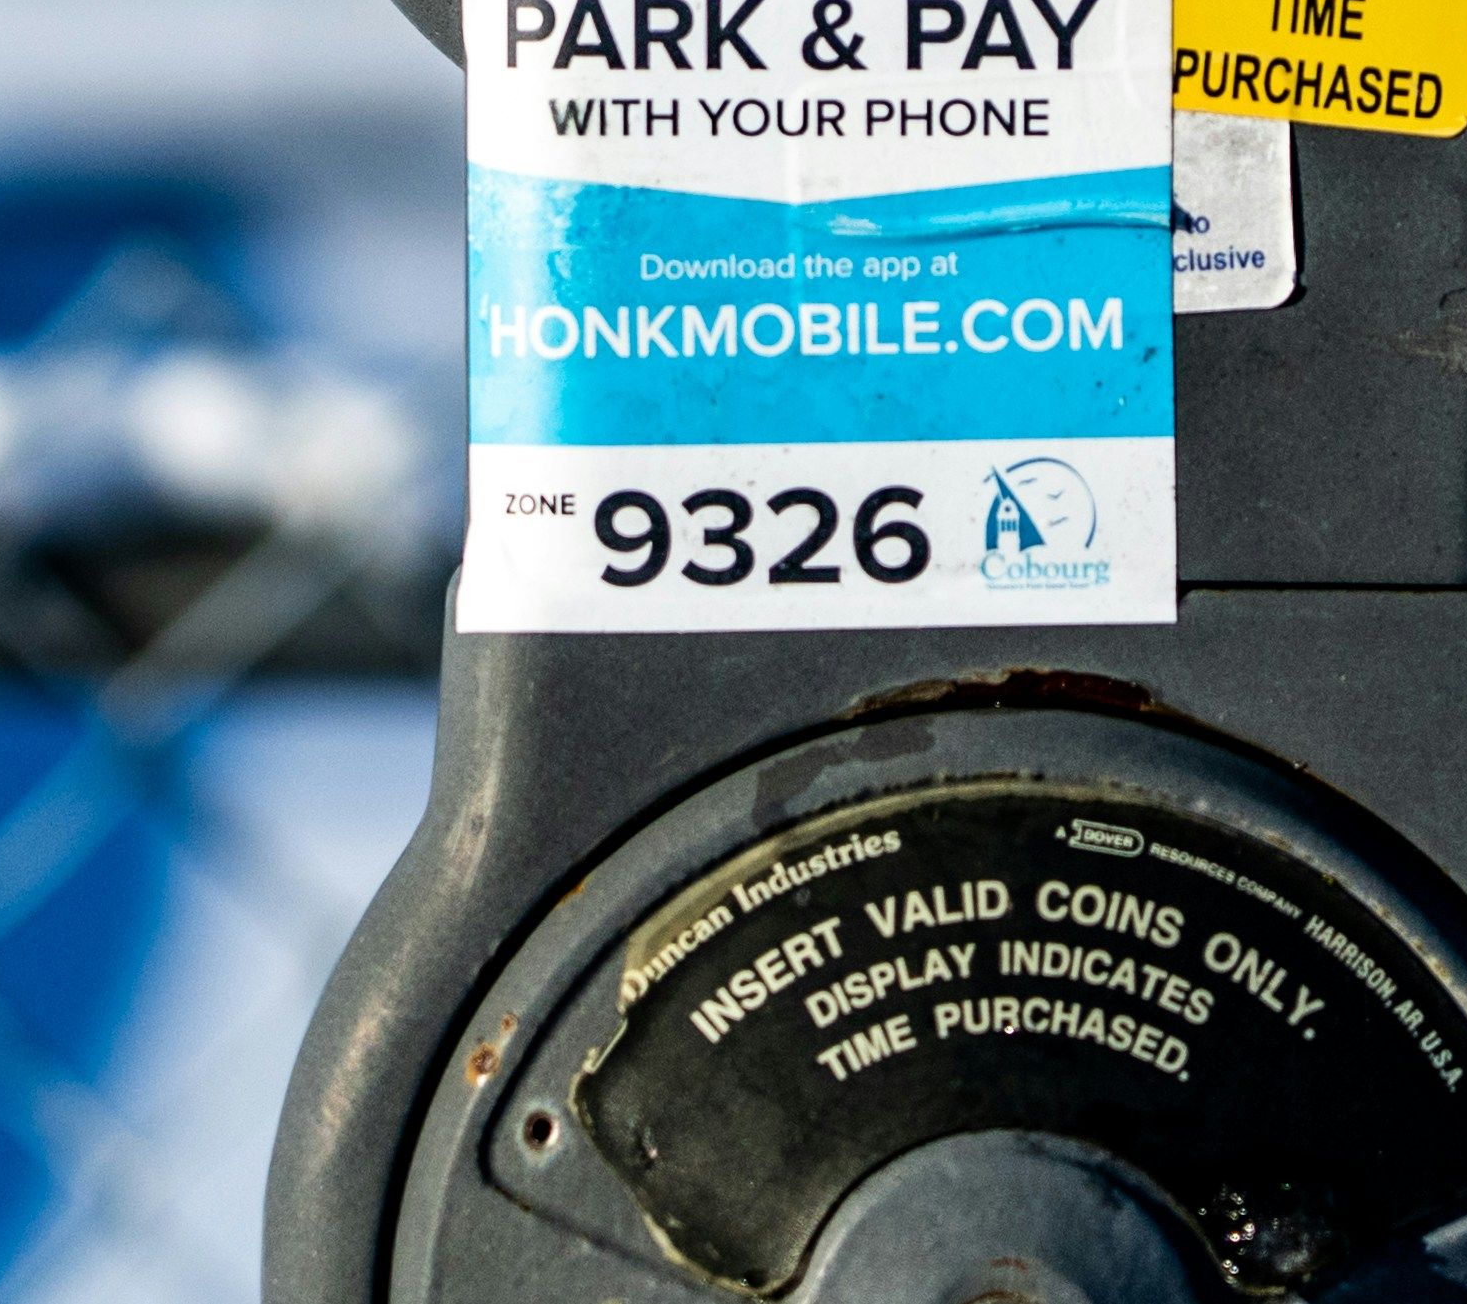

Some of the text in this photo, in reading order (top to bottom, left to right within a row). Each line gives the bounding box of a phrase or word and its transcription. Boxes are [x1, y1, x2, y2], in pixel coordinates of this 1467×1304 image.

[550, 99, 1048, 136] WITH YOUR PHONE
[1173, 48, 1442, 119] PURCHASED
[641, 252, 958, 281] Download the app at
[1173, 245, 1265, 272] clusive
[491, 298, 1124, 359] HONKMOBILE.COM
[507, 487, 930, 587] ZONE 9326
[980, 551, 1110, 585] Cobourg
[1083, 828, 1134, 849] DOVER
[1236, 875, 1302, 919] COMPANY
[619, 830, 902, 1005] Duncan Industries
[688, 880, 1326, 1044] INSERT VALID COINS ONLY.
[804, 941, 1214, 1030] DISPLAY INDICATES
[816, 996, 1191, 1083] TIME PURCHASED.
